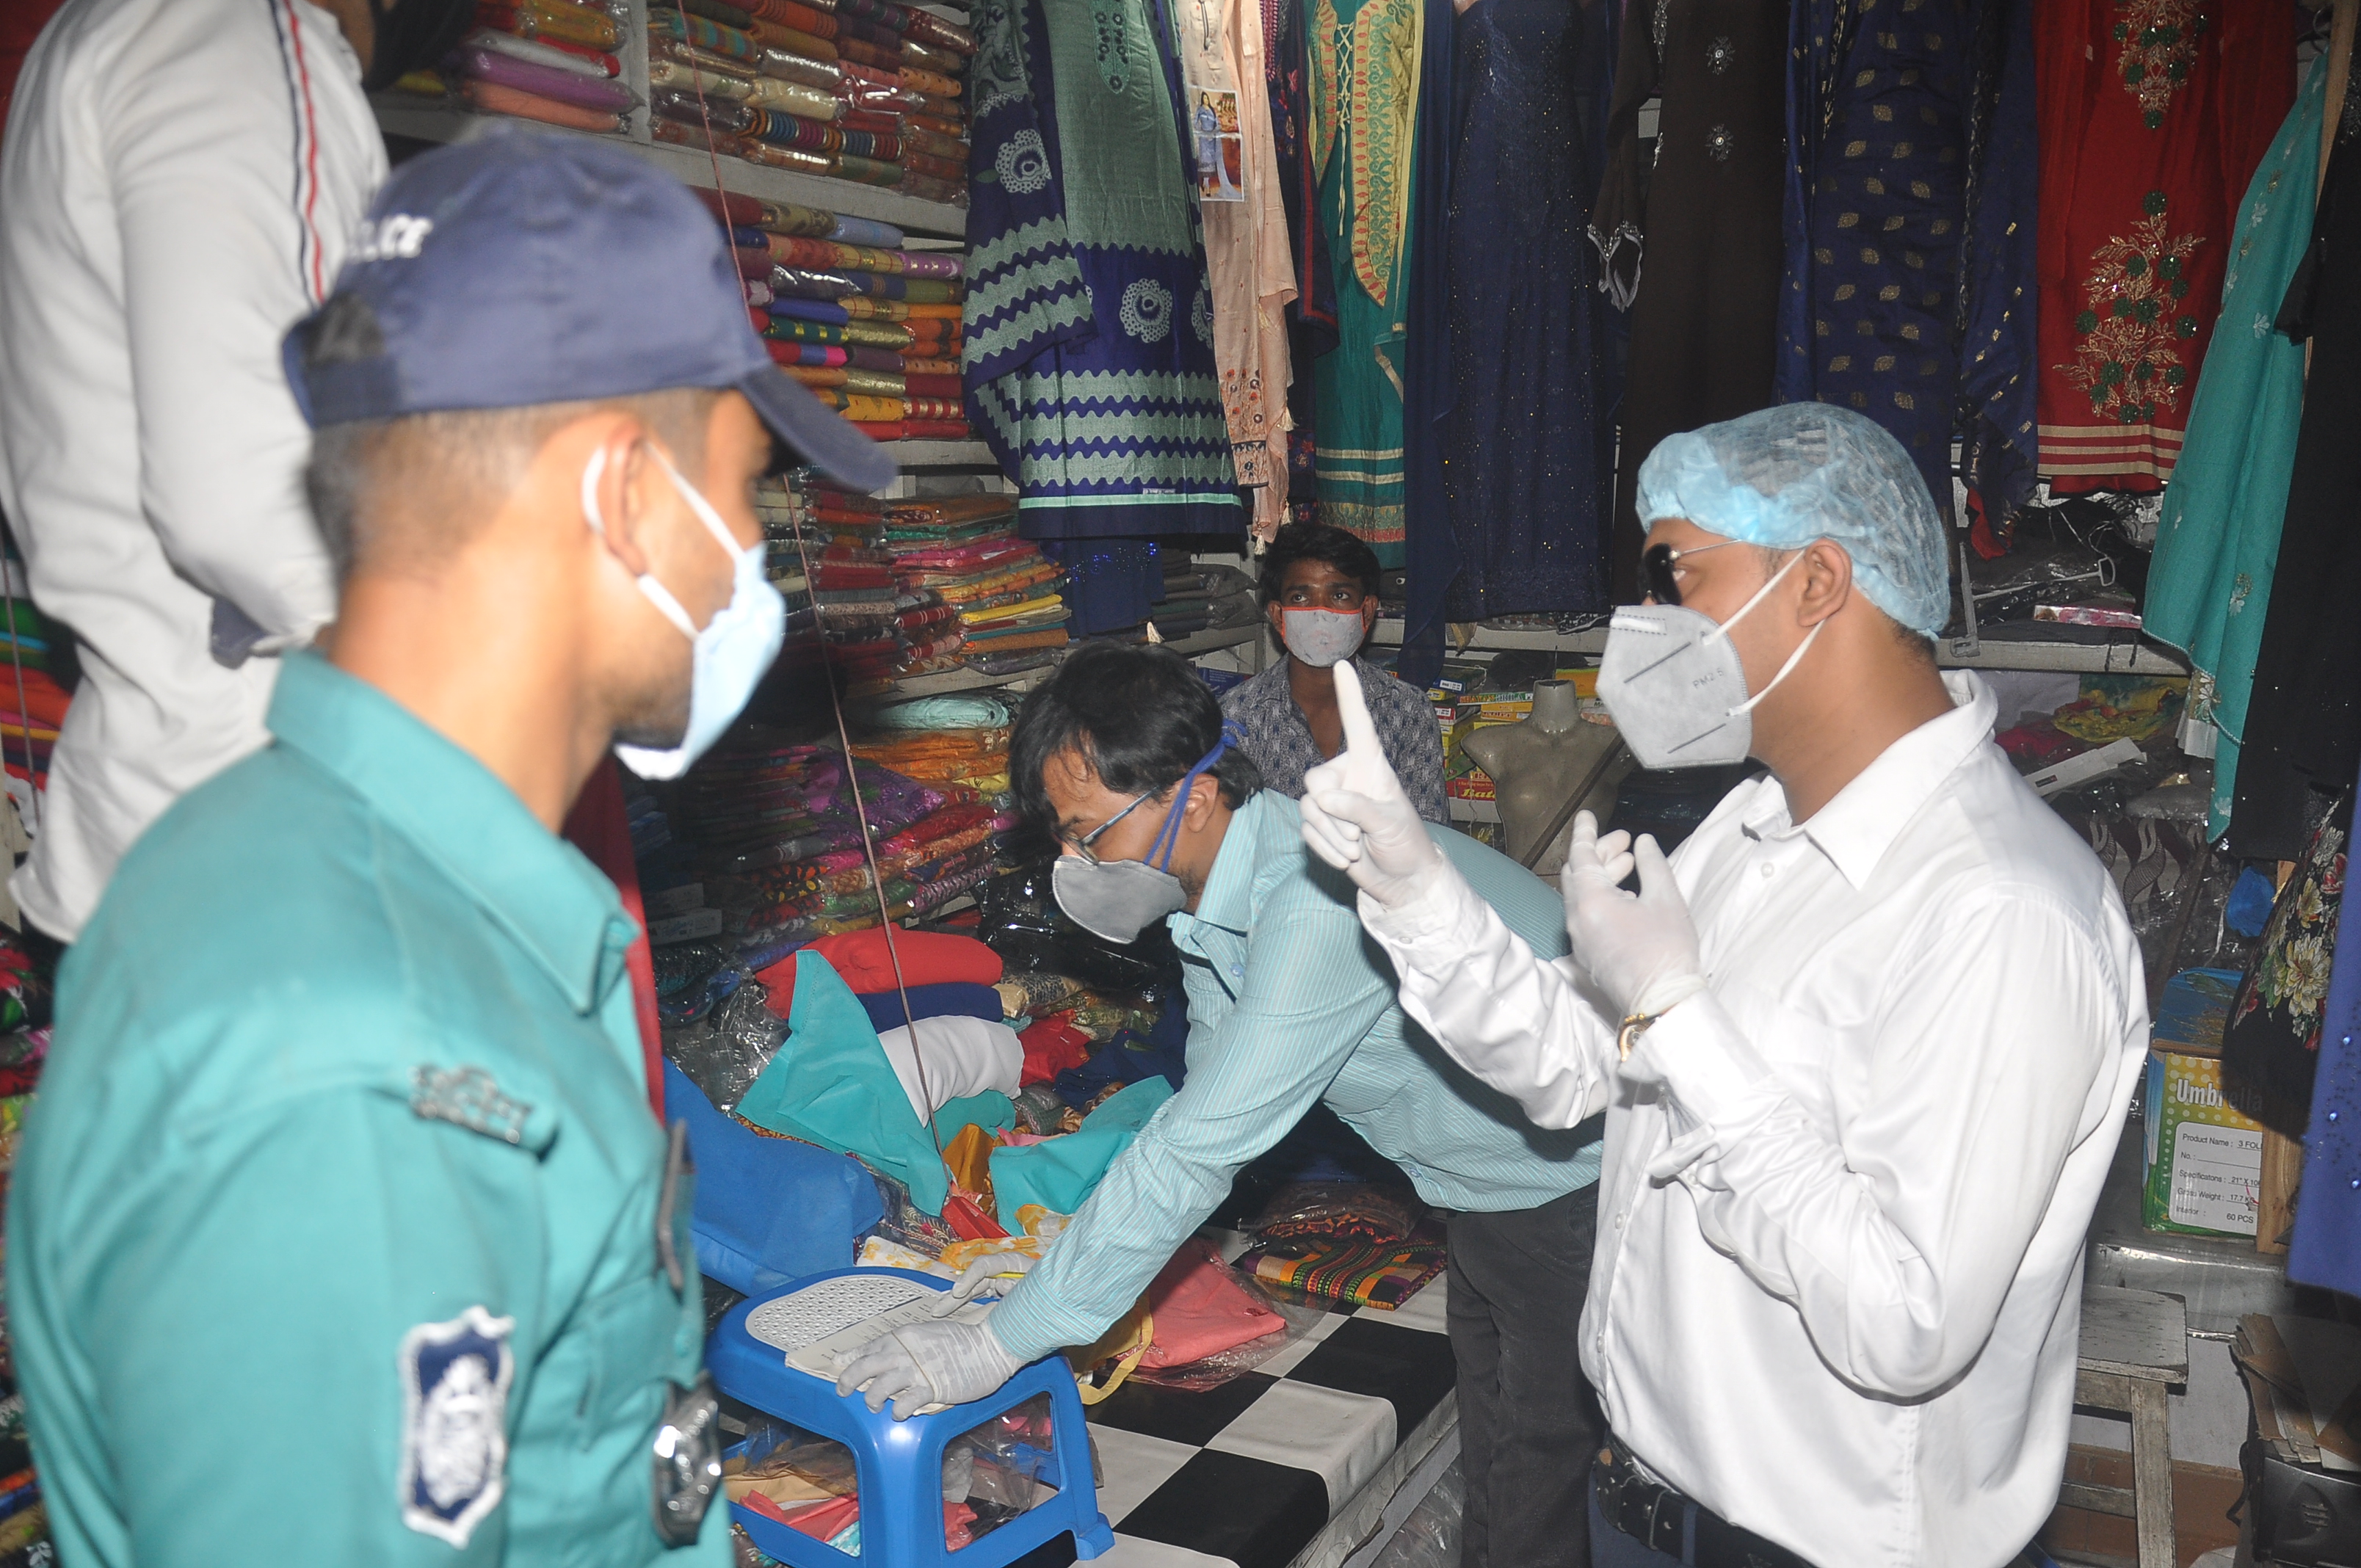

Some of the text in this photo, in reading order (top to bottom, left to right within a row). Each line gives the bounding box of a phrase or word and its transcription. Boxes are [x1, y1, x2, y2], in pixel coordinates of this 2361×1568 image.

[2183, 1133, 2208, 1143] Product
[2209, 1137, 2229, 1147] Name
[2180, 1152, 2191, 1160] No.
[2199, 1190, 2222, 1202] Weight
[2230, 1194, 2244, 1202] 17.7
[2238, 1214, 2254, 1224] PCS
